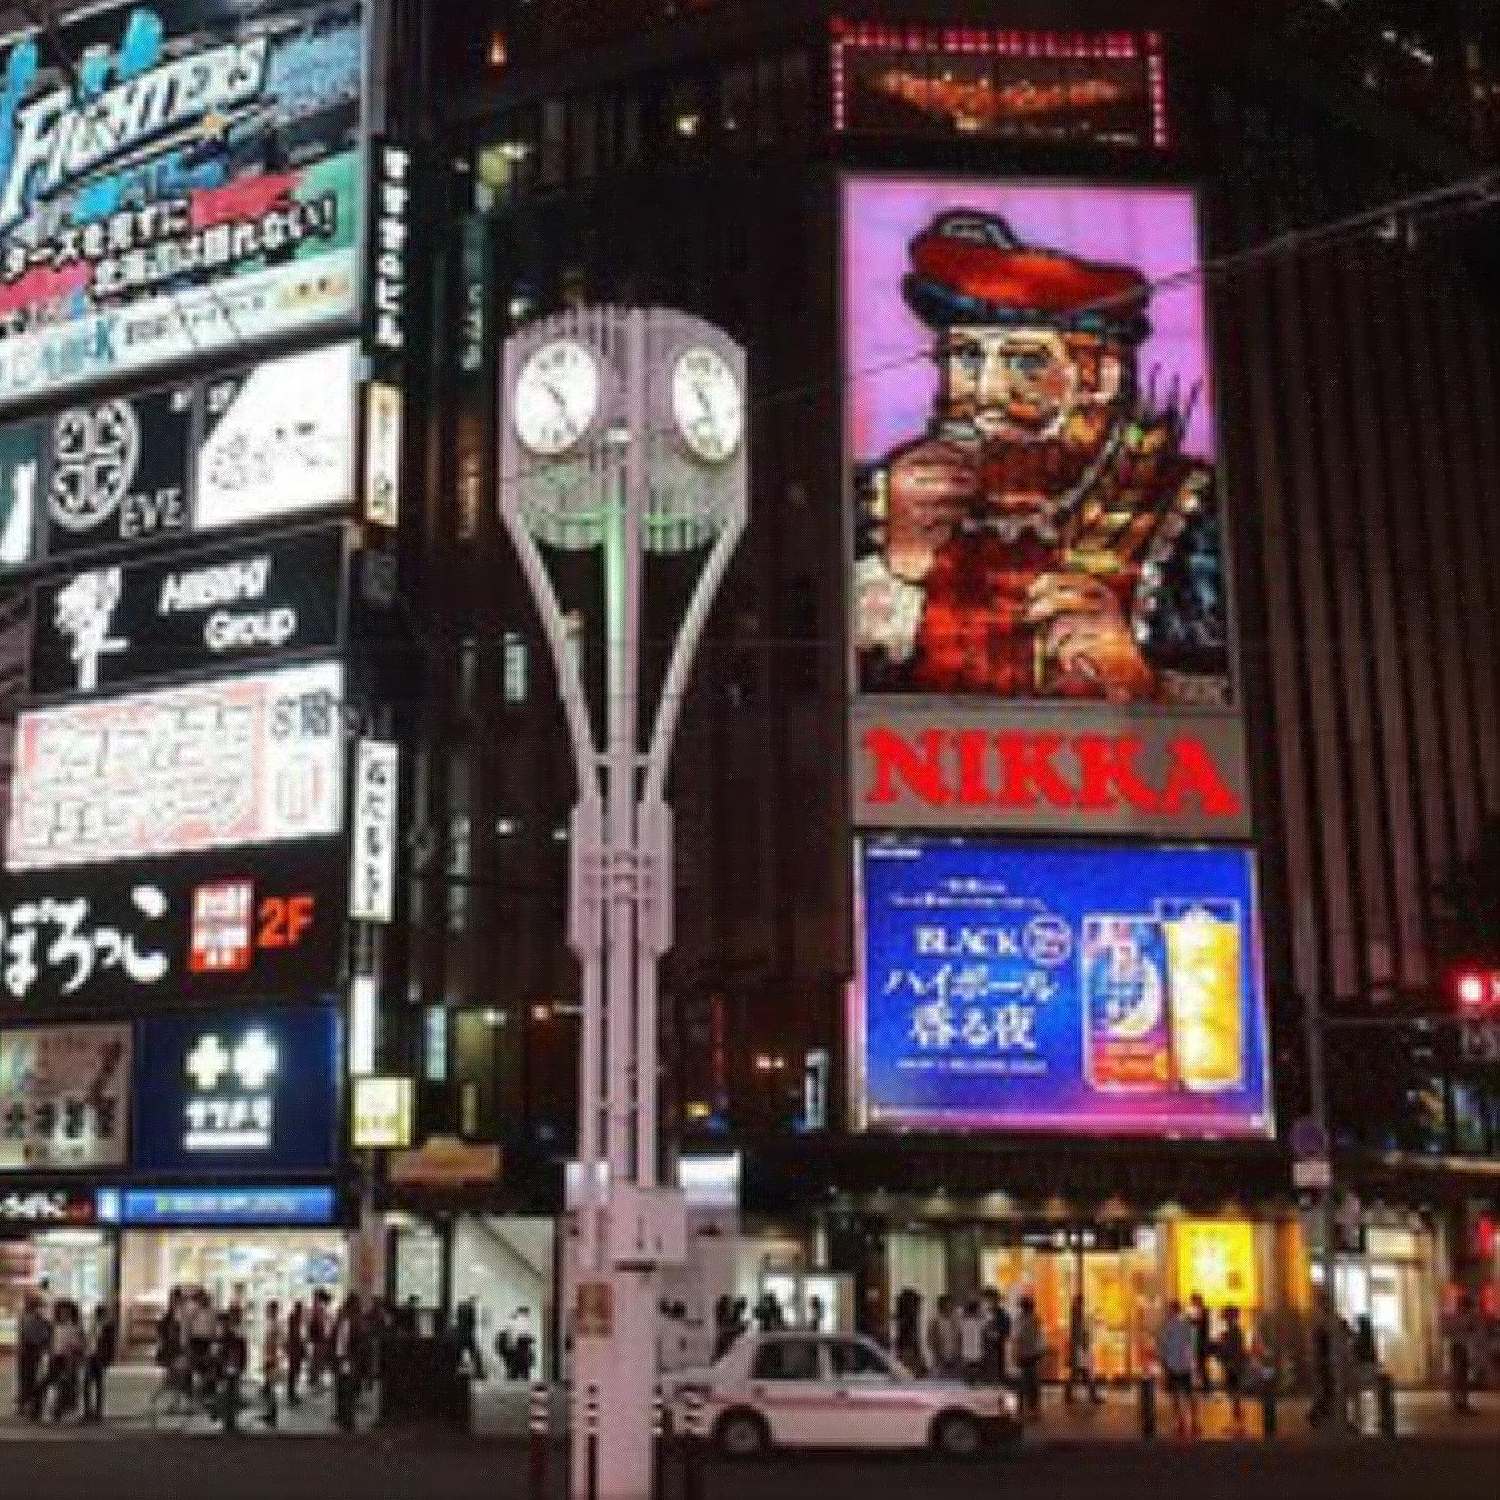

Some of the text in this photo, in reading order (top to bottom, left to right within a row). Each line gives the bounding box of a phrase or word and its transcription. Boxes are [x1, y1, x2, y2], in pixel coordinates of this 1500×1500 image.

[119, 486, 185, 539] EVE
[204, 609, 297, 650] Group
[864, 726, 1244, 819] NIKKA
[258, 896, 315, 949] 2F
[915, 925, 1020, 957] BLACK
[883, 964, 1059, 1002] ハイボール
